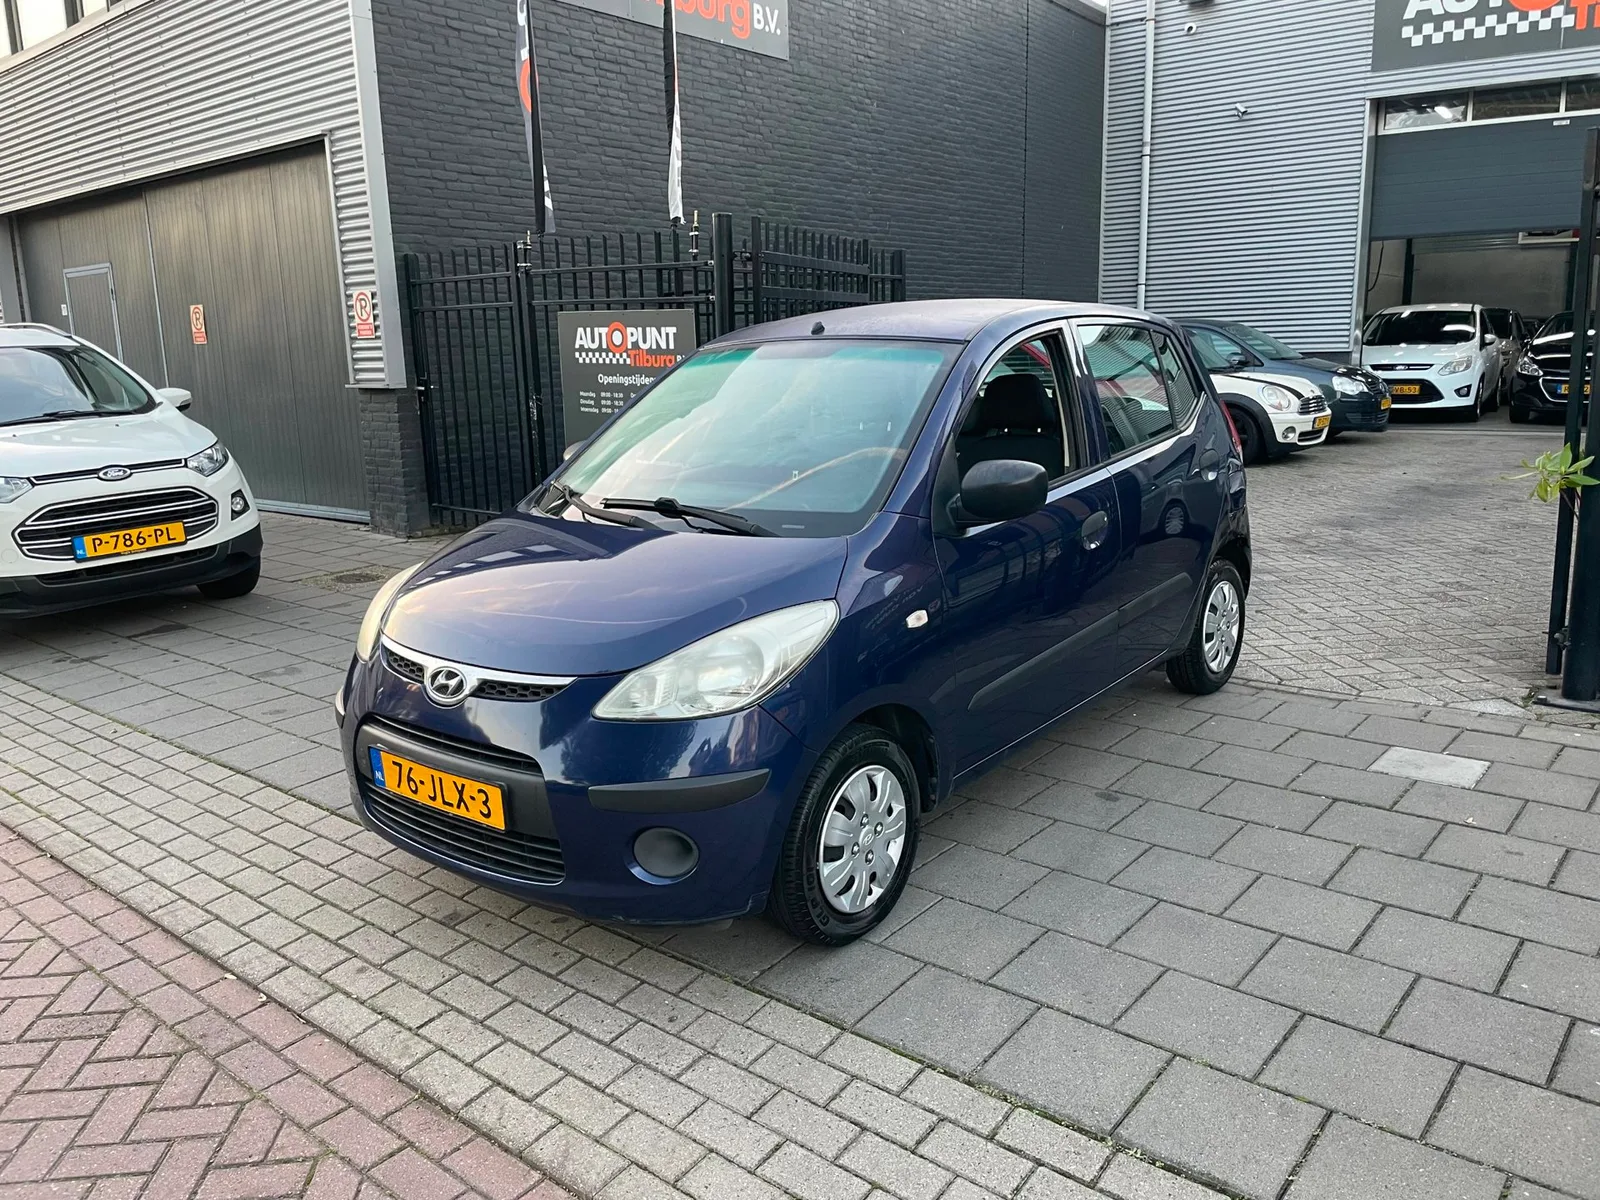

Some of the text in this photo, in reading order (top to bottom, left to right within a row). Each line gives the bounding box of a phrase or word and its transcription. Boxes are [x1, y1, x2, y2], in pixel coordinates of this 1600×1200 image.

[753, 2, 781, 35] B.V.
[574, 321, 677, 354] AUTOPUNT
[92, 526, 176, 553] P-786-PL
[375, 760, 492, 819] NL 76-JLX-3
